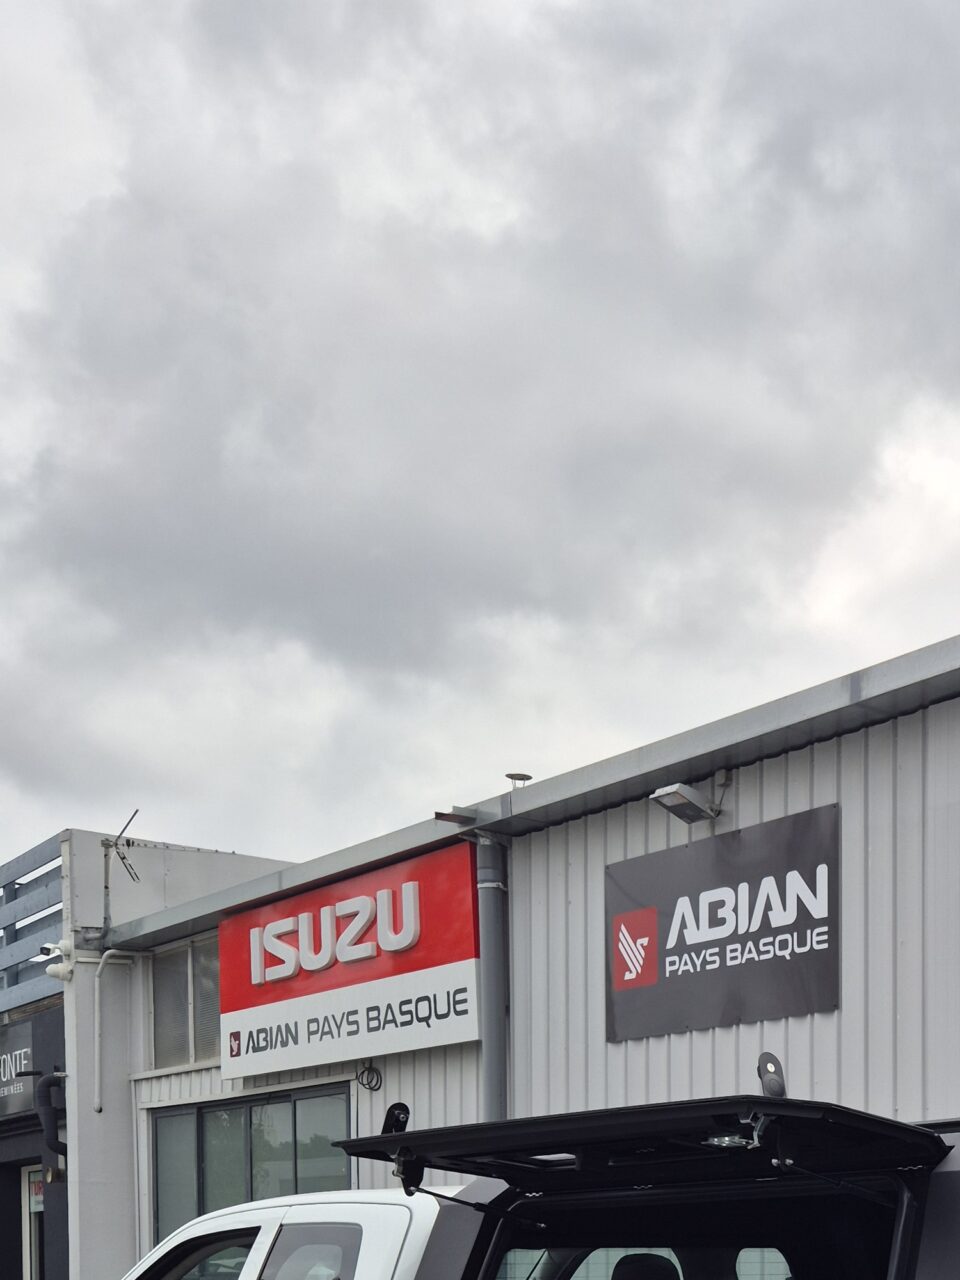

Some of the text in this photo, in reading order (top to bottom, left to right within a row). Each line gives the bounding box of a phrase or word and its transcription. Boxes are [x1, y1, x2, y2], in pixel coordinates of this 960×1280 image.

[250, 881, 421, 986] ISUZU
[665, 863, 829, 950] ABIAN
[665, 926, 829, 978] PAYS BASQUE
[245, 987, 469, 1055] ABIAN PAYS BASQUE
